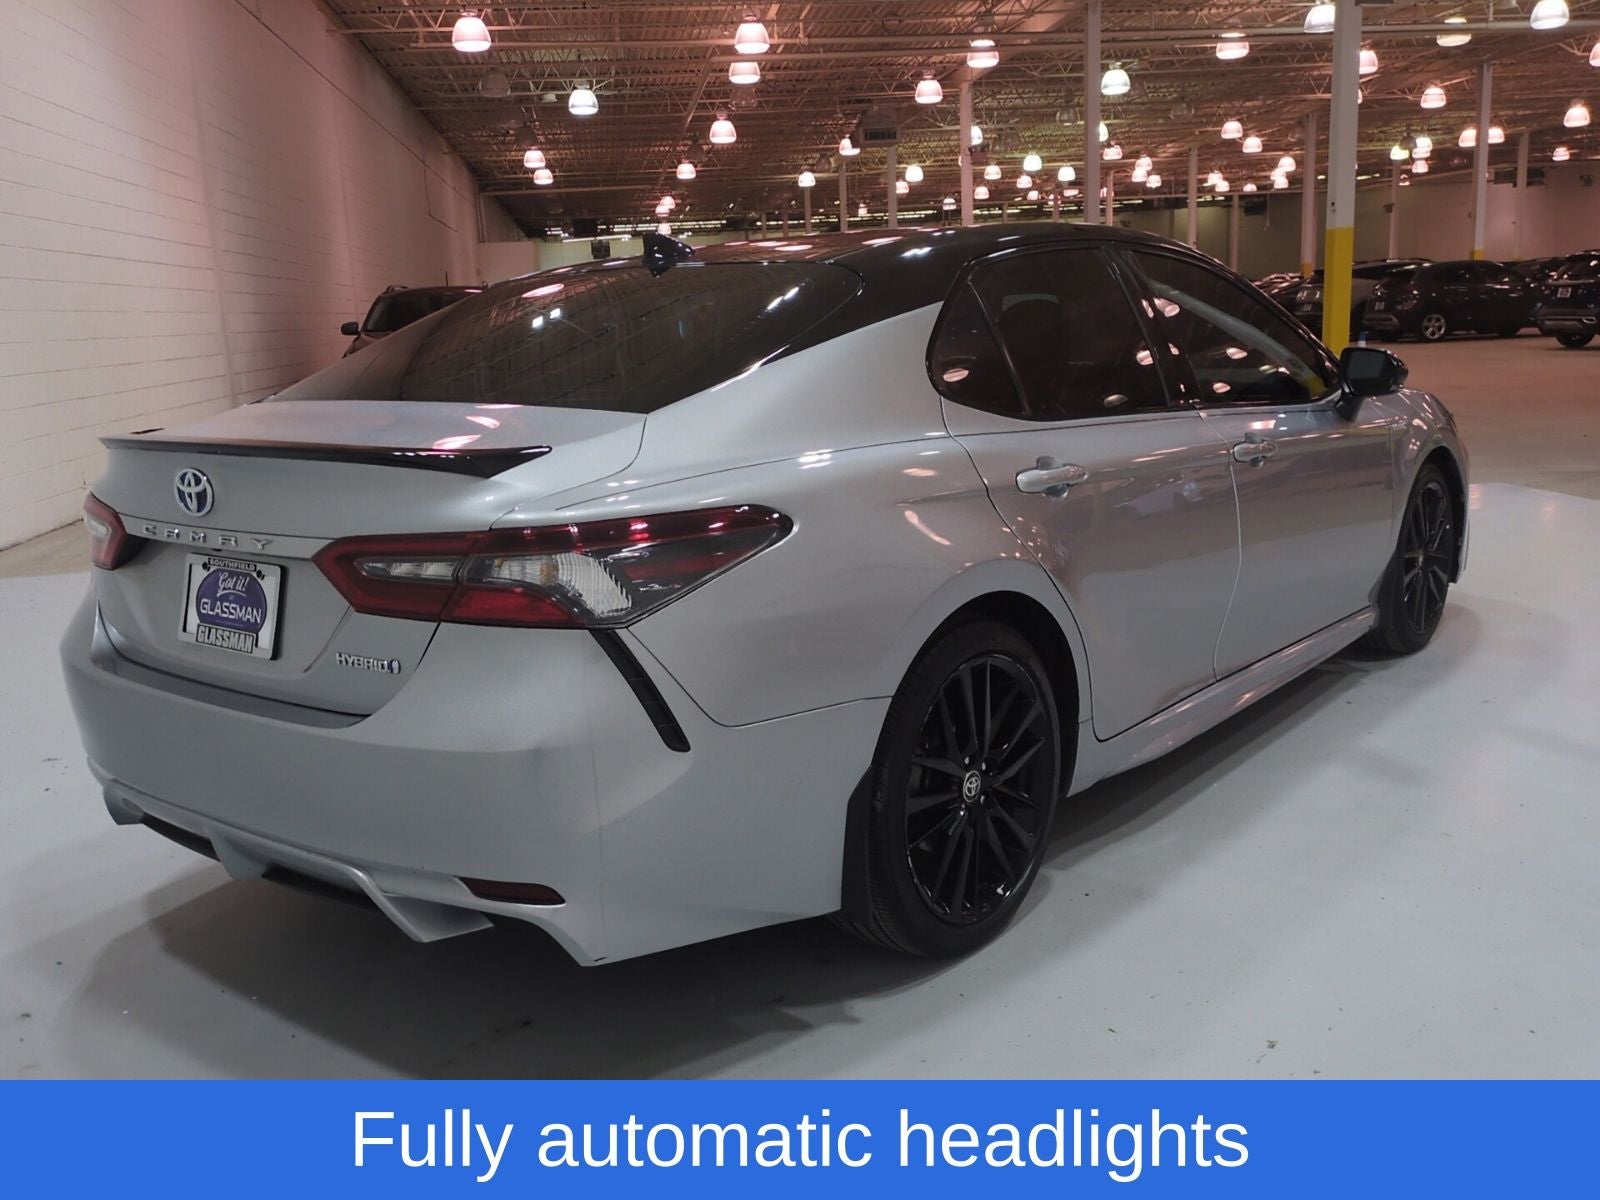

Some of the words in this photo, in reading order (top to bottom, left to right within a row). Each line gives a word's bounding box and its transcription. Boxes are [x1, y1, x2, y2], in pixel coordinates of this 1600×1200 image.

[143, 524, 273, 551] CAMRY
[210, 558, 256, 571] SOUTHFIELD
[200, 598, 262, 624] GLASSMAN
[197, 624, 254, 653] GLASSMAN
[336, 652, 389, 673] HYBRID
